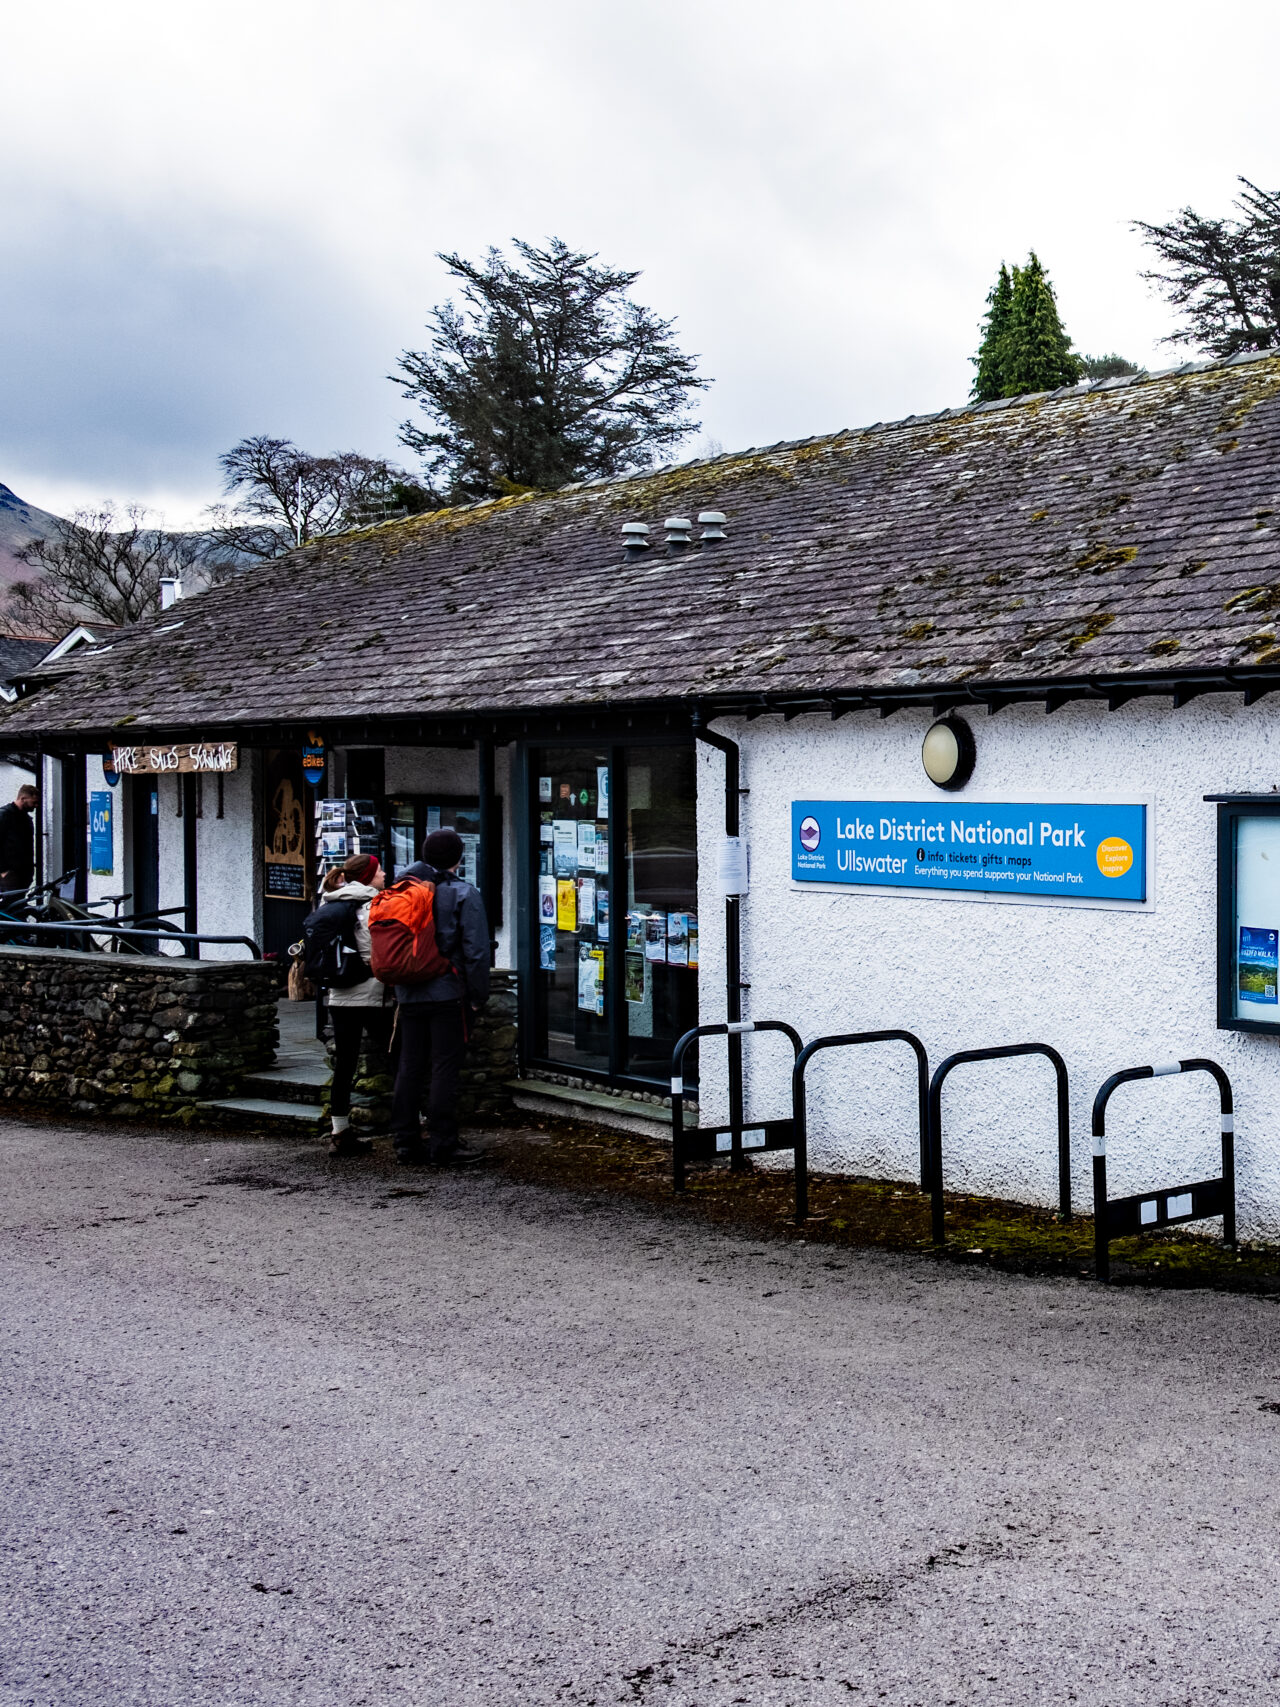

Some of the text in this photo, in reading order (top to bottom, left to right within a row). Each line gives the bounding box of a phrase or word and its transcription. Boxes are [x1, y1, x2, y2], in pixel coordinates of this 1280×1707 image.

[112, 746, 138, 774] HIRE
[150, 746, 179, 771] SALES
[303, 754, 325, 767] eBikes
[836, 817, 1087, 848] Lake District National Park
[1101, 844, 1128, 852] Discover
[797, 861, 826, 870] National Park
[808, 854, 825, 862] District
[836, 849, 908, 874] Ullswater
[927, 850, 1032, 869] info tickets gifts maps
[1105, 854, 1128, 863] Explore
[914, 865, 1084, 884] Everything you spend supports your National Park
